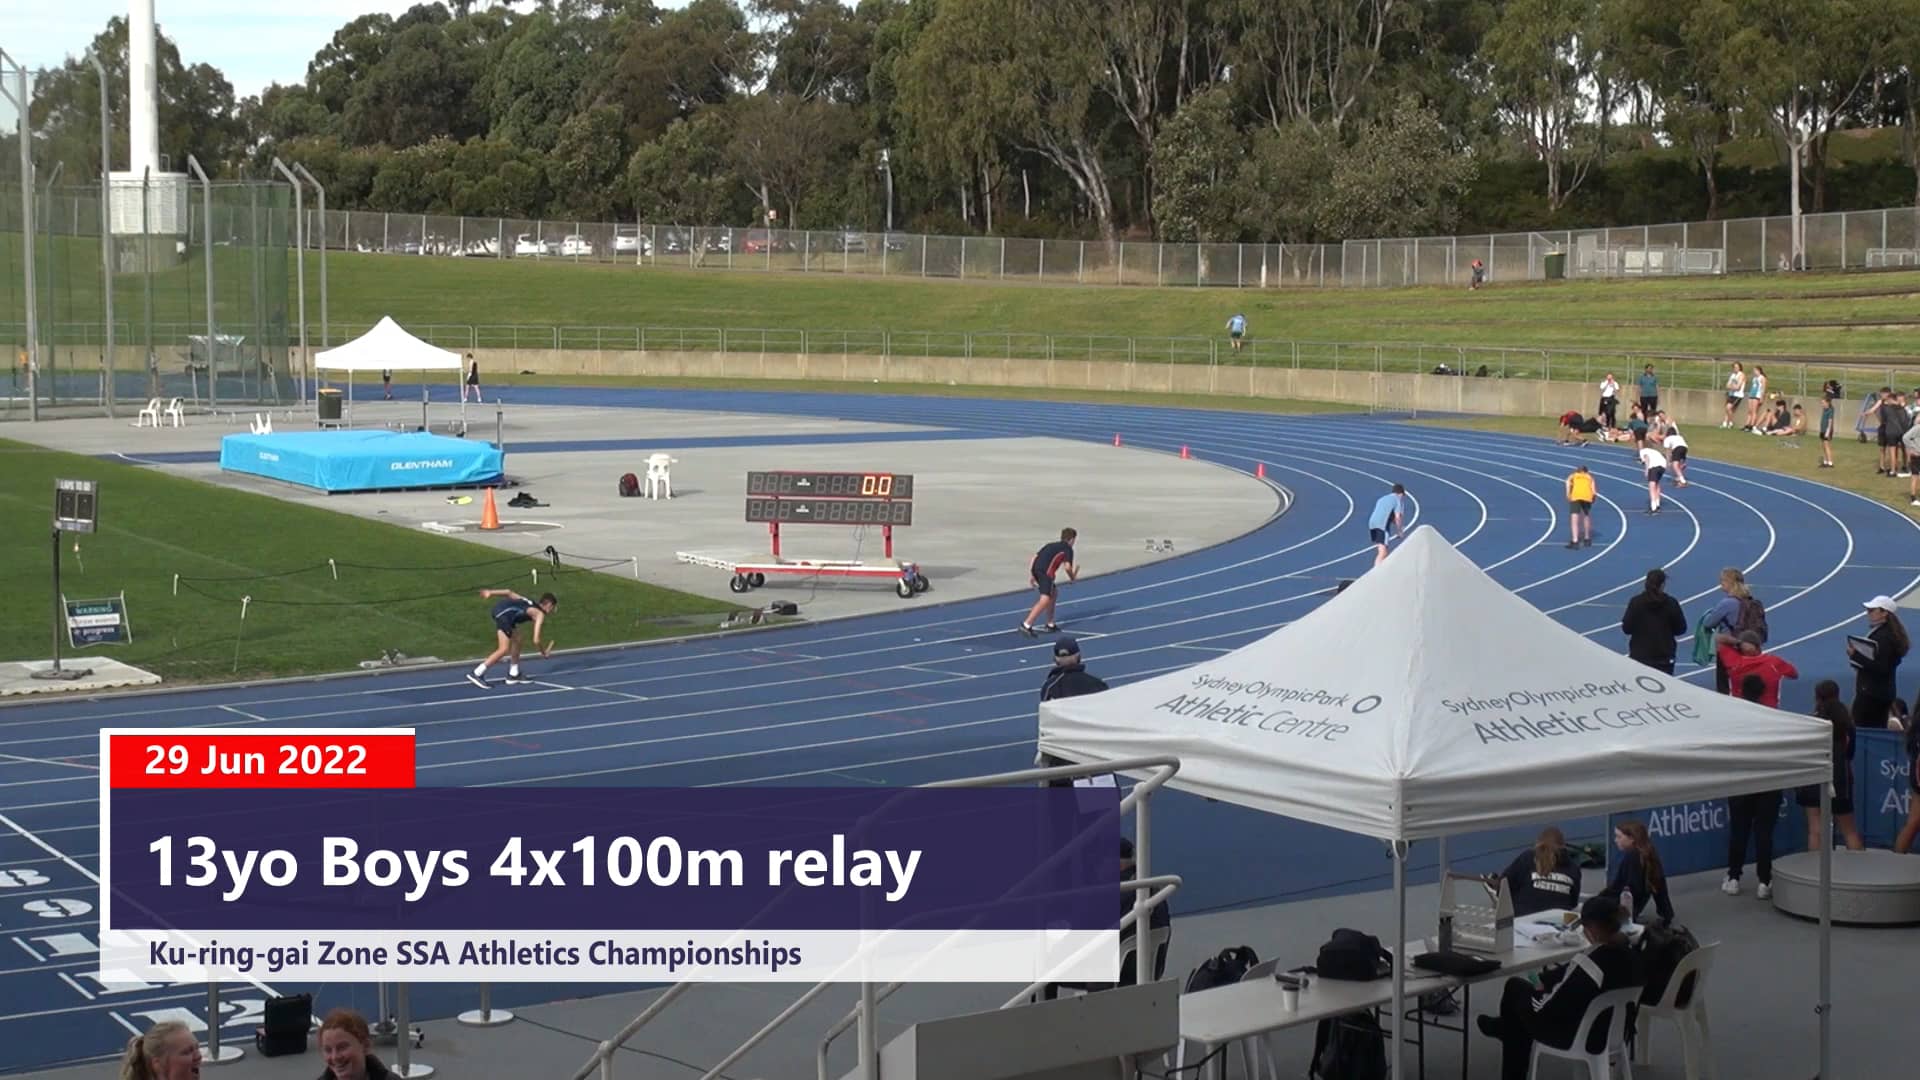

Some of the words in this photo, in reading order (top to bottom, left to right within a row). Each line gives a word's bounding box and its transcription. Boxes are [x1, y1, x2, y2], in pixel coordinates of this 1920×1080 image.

[1192, 673, 1349, 708] SydneyOlympicPark
[1442, 679, 1632, 715] SydneyOlympicPark
[1648, 802, 1724, 837] Athletic
